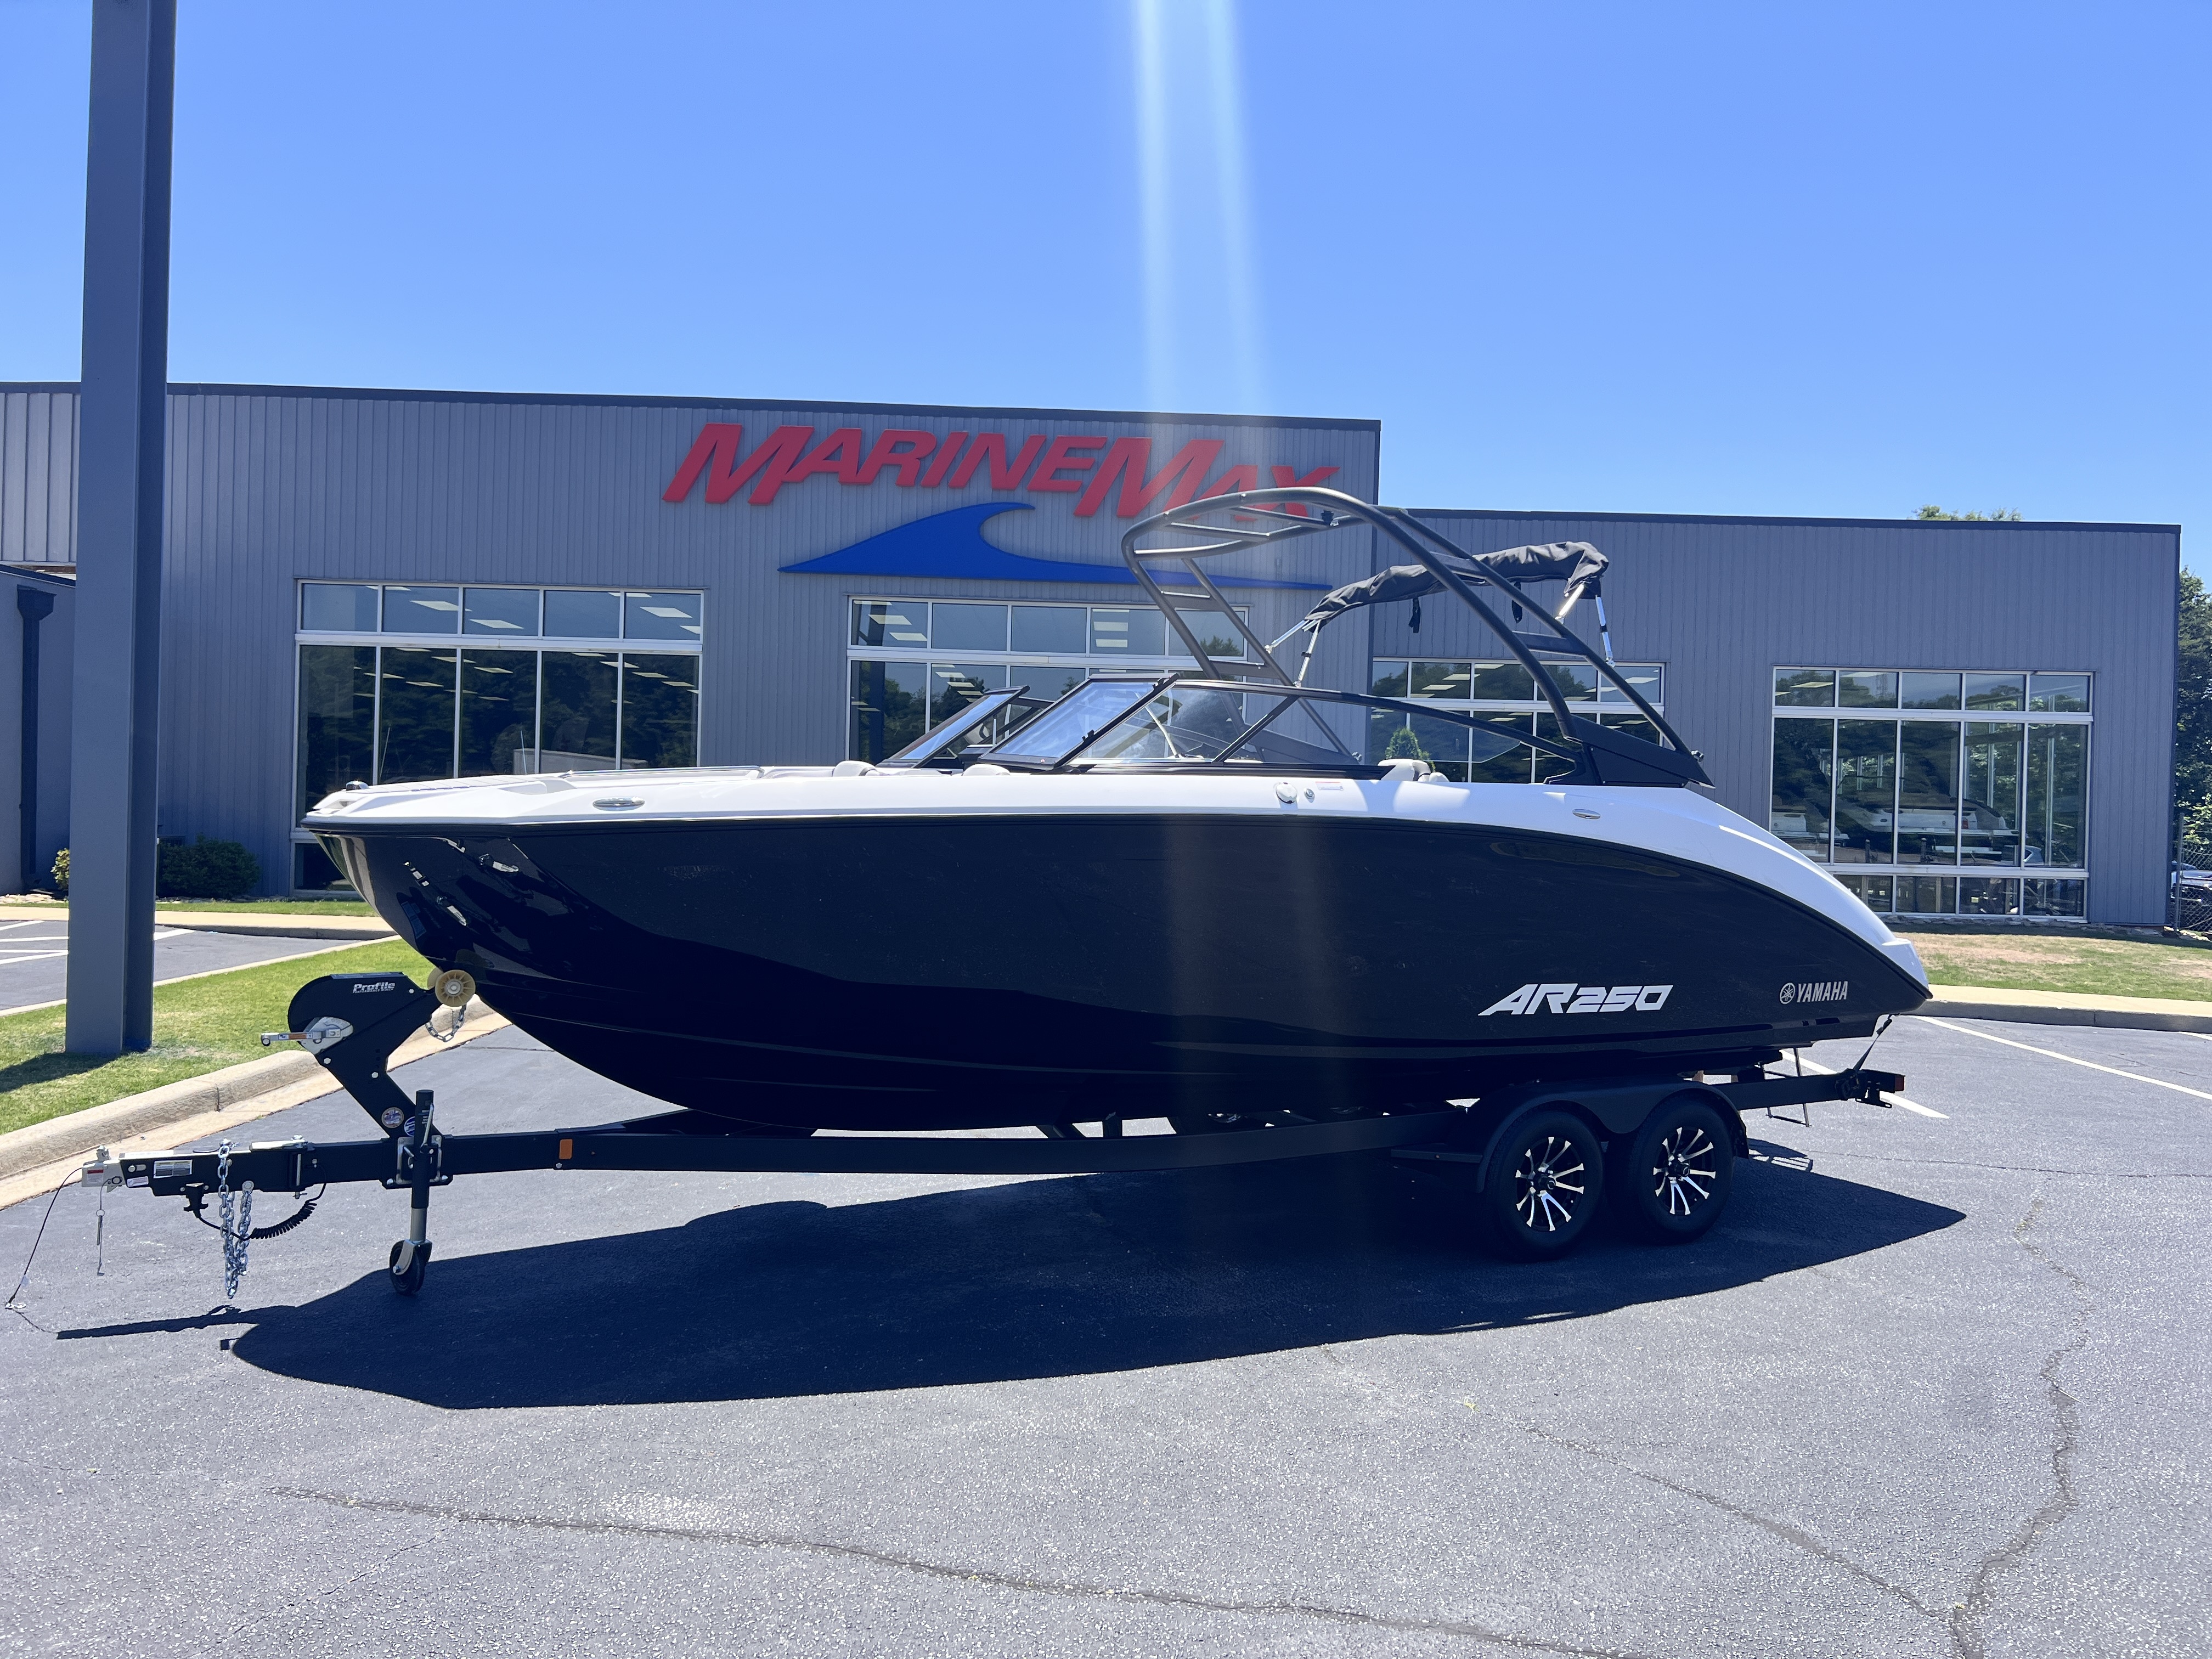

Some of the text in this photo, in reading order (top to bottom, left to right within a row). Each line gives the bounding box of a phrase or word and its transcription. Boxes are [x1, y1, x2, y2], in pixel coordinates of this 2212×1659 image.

[353, 982, 395, 991] Profile
[1796, 980, 1848, 1003] YAMAHA
[1477, 983, 1673, 1016] AR250
